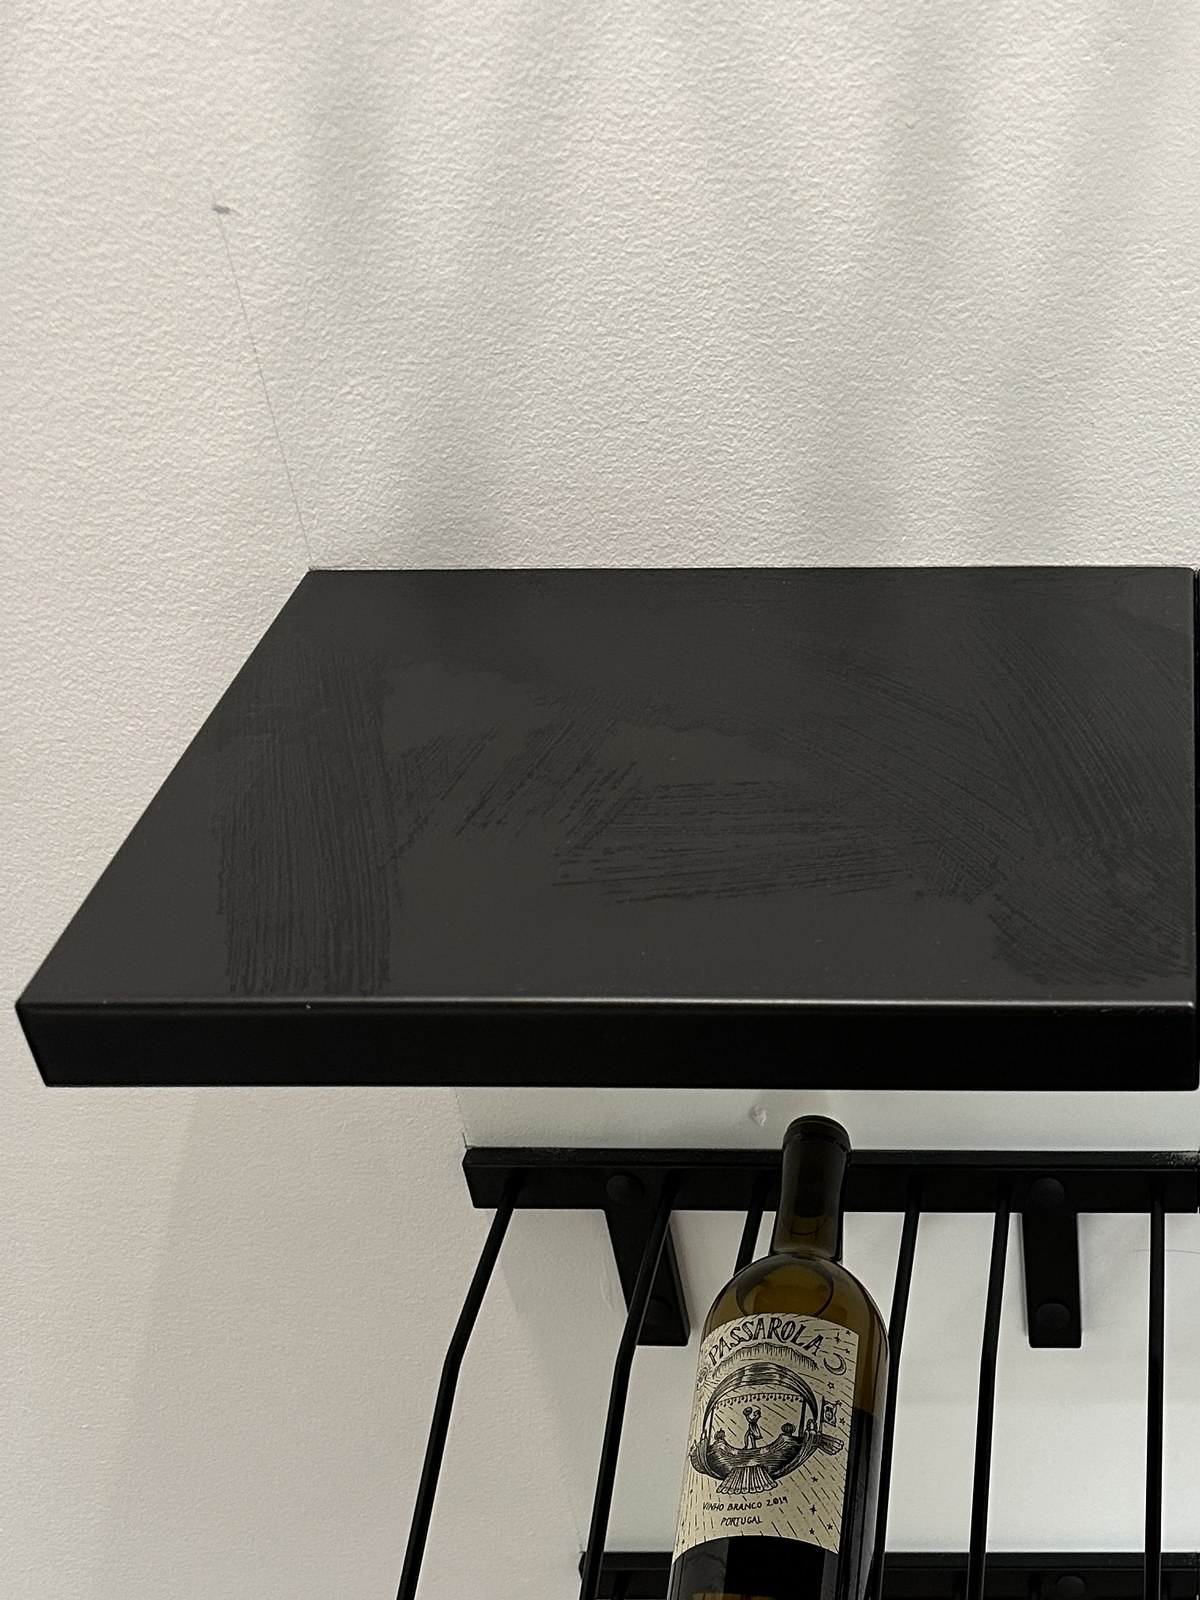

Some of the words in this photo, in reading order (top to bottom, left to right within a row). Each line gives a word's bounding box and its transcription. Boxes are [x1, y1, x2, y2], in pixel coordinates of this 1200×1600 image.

[709, 1317, 824, 1366] PASSAROLA
[727, 1502, 763, 1511] BRANCO
[720, 1515, 763, 1527] PORTUGAL
